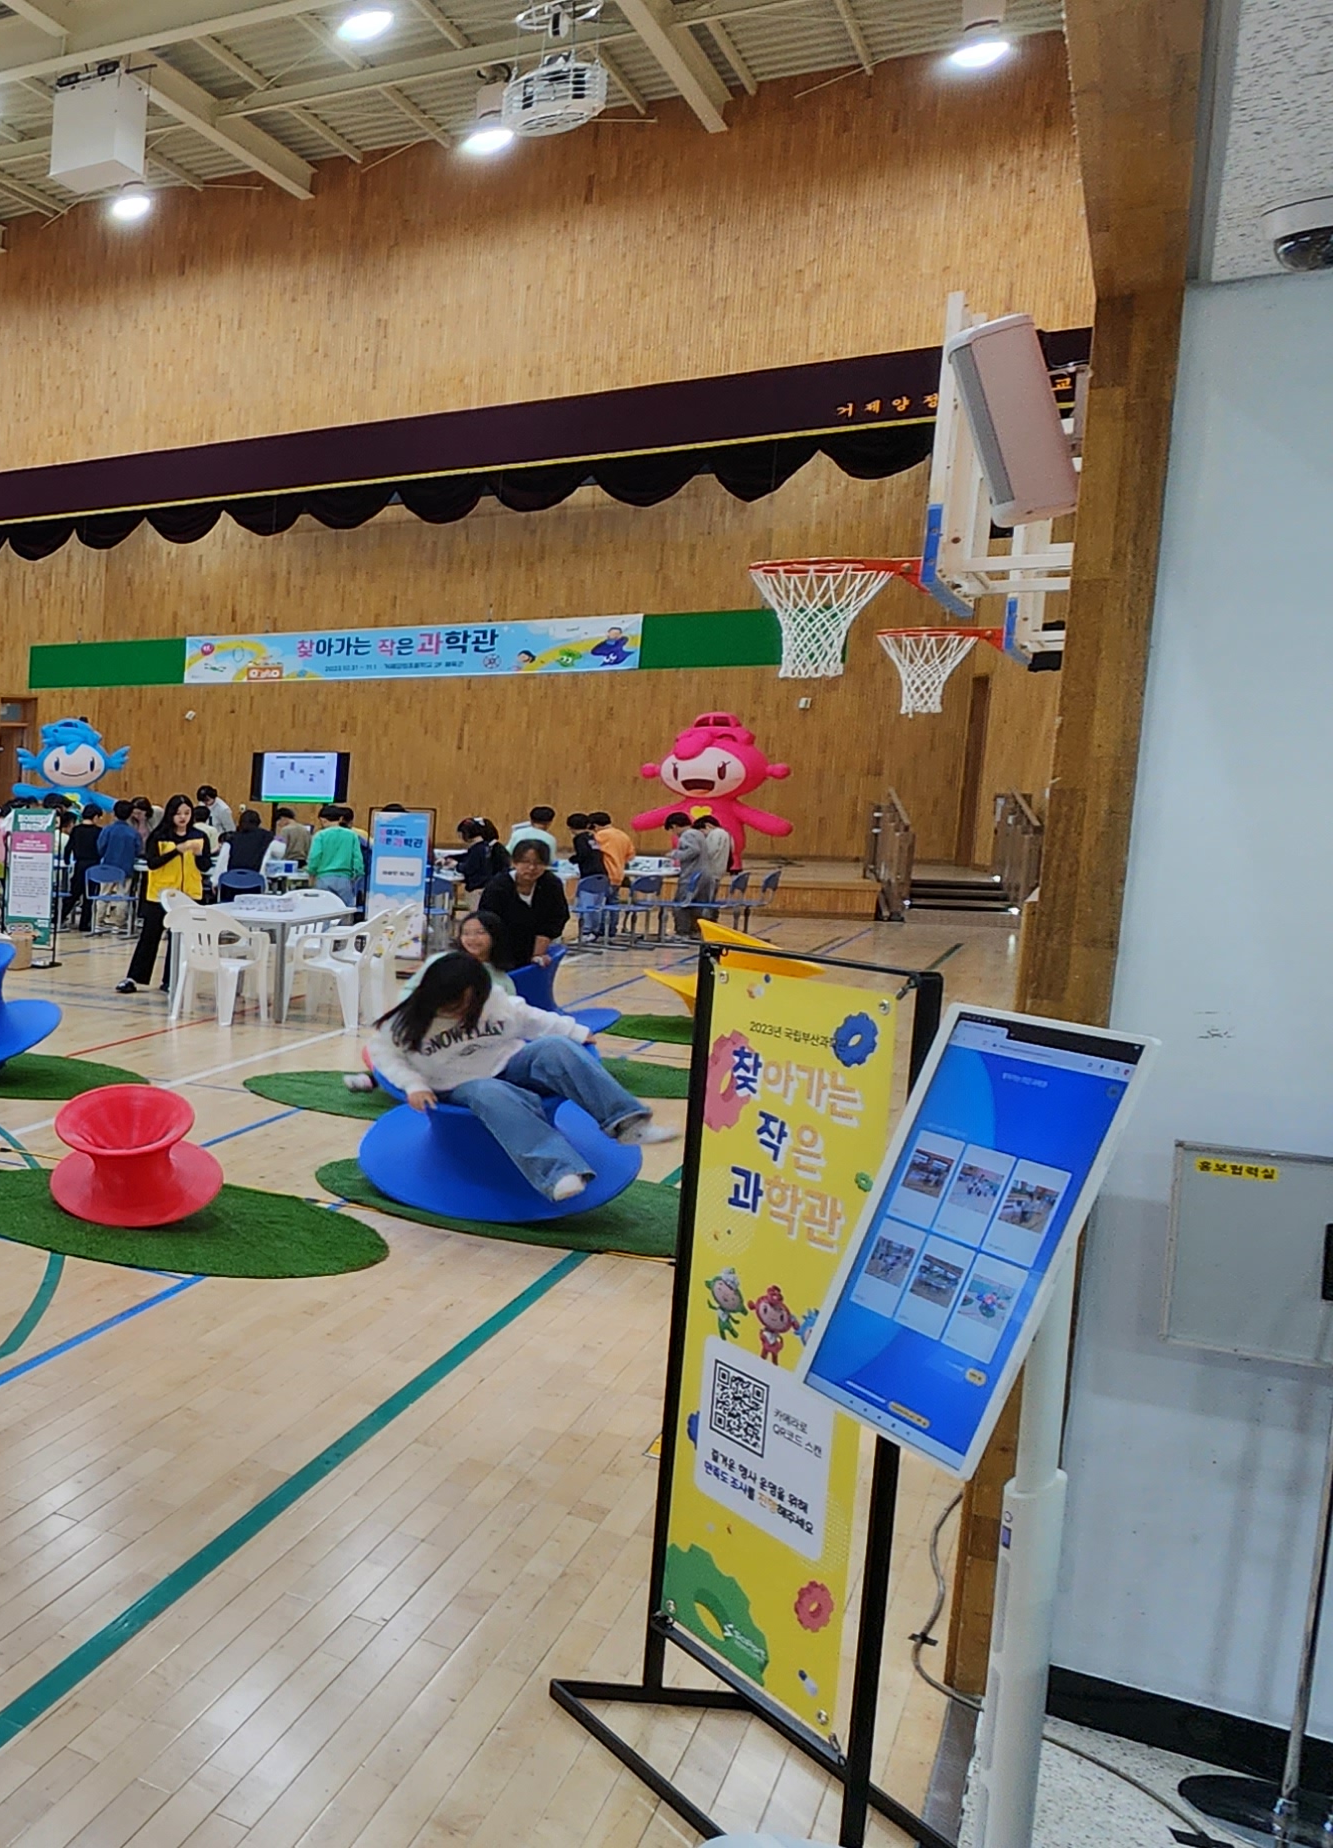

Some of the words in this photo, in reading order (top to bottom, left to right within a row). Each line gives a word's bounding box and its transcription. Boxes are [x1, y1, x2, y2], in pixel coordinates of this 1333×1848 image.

[297, 637, 372, 659] 찾아가는
[378, 638, 414, 657] 작은
[417, 629, 499, 655] 과학관
[749, 1021, 782, 1039] 2023년
[732, 1046, 861, 1122] 찾아가는
[756, 1110, 823, 1176] 작은
[728, 1166, 843, 1249] 과학관
[773, 1408, 808, 1435] 카메라로
[773, 1423, 803, 1447] QR코드
